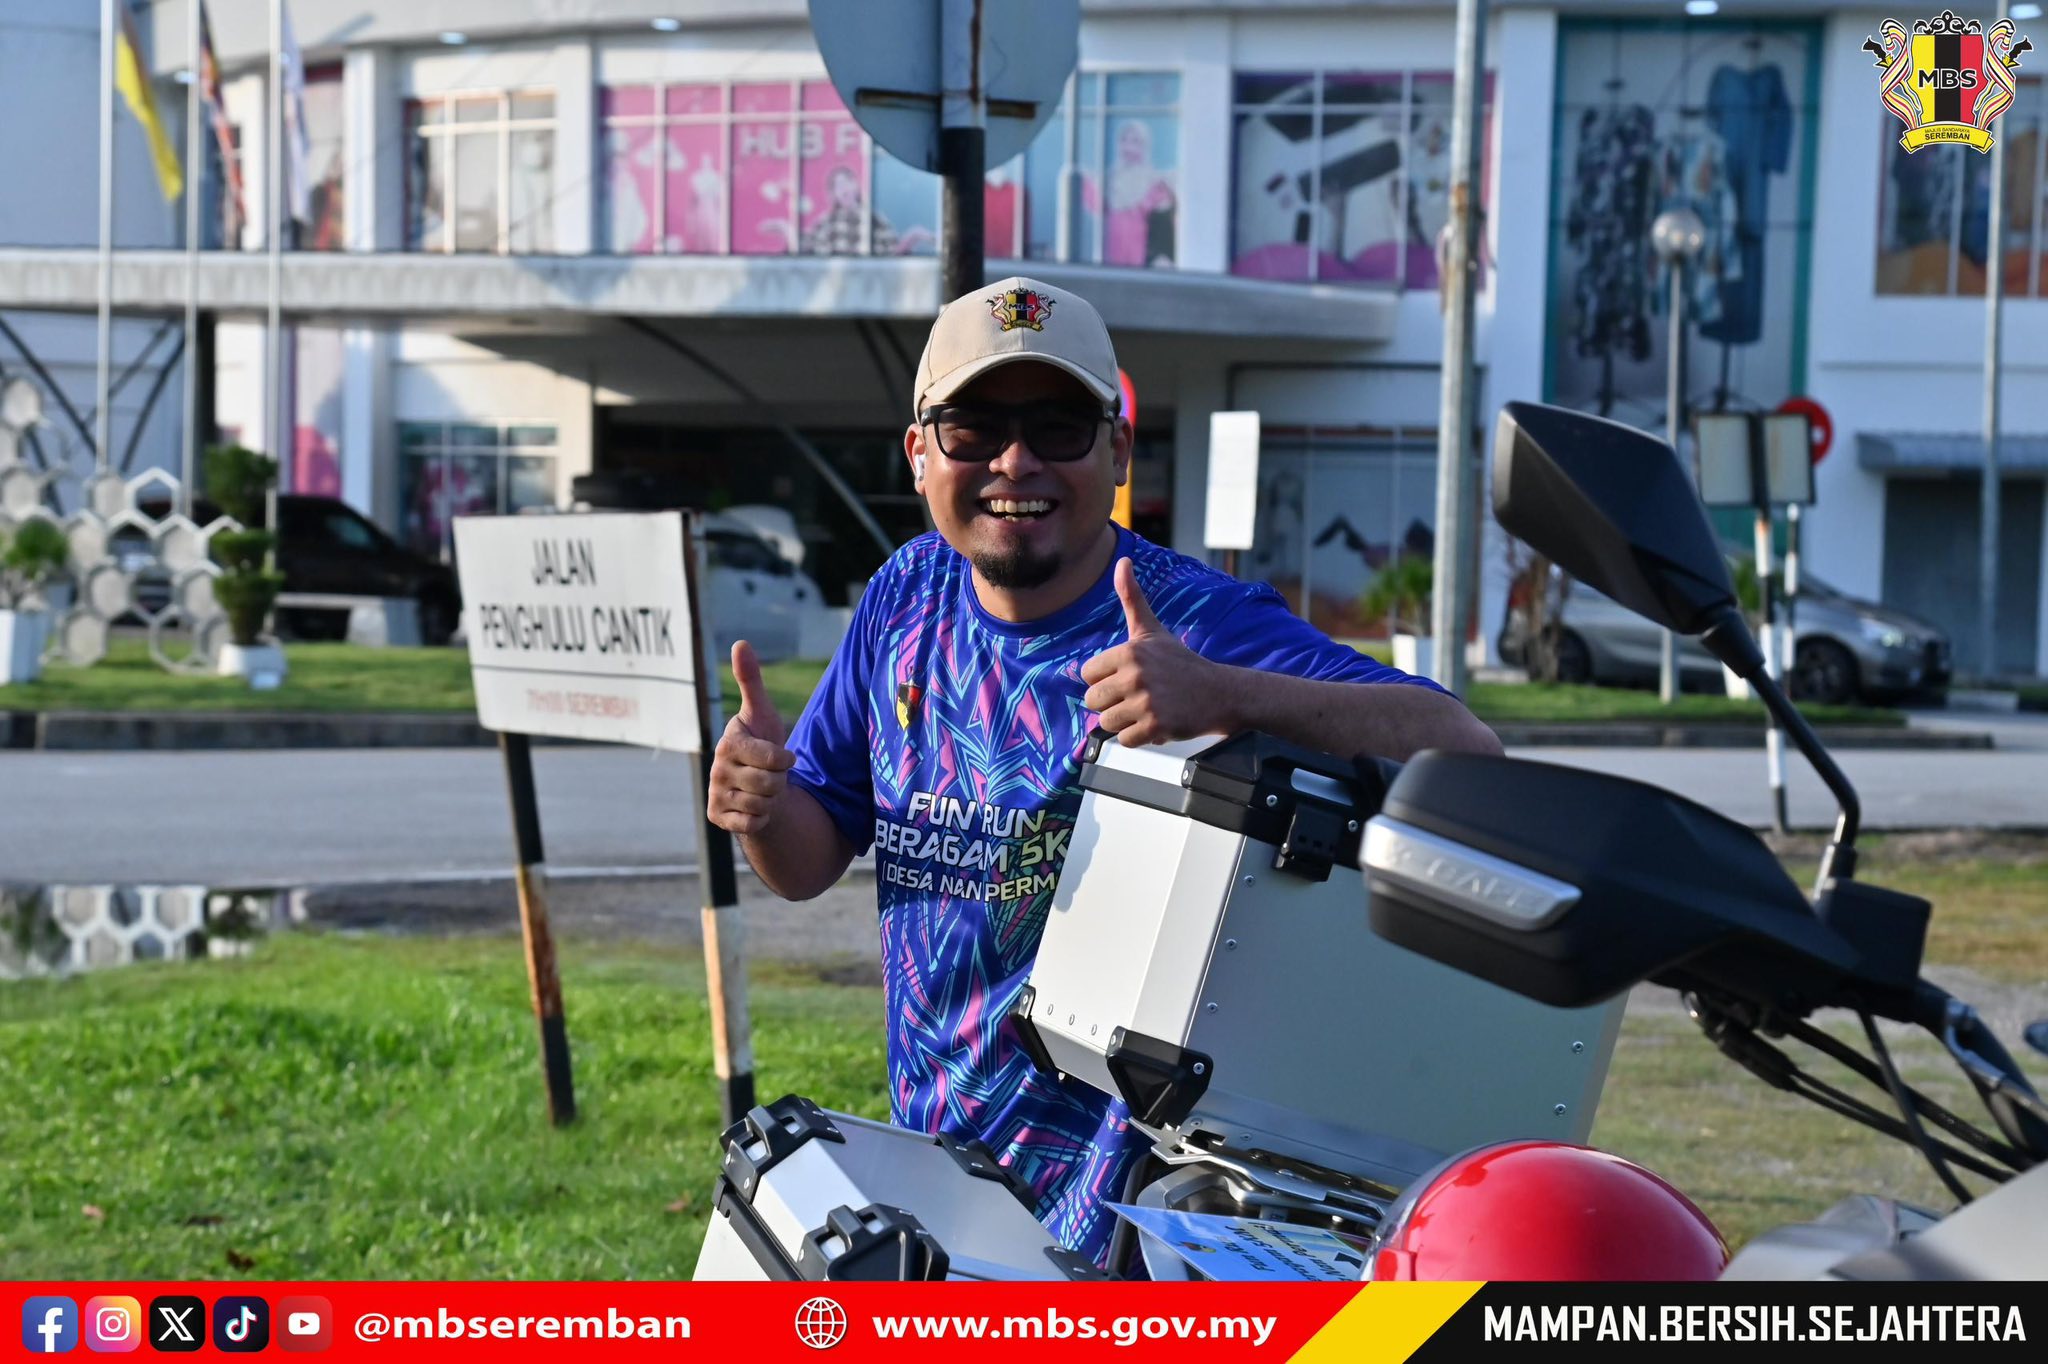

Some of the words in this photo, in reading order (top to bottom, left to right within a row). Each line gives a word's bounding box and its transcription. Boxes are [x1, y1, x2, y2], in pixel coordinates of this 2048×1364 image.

[739, 122, 826, 160] HUB
[532, 538, 597, 586] JALAN
[481, 603, 587, 653] PENGHULU
[592, 606, 676, 658] CANTIK
[907, 792, 977, 830] FUN
[981, 803, 1046, 838] RUN
[874, 818, 1010, 873] BERAGAM
[881, 859, 934, 892] (DESA
[939, 874, 982, 901] NAN
[984, 872, 1057, 902] PERM
